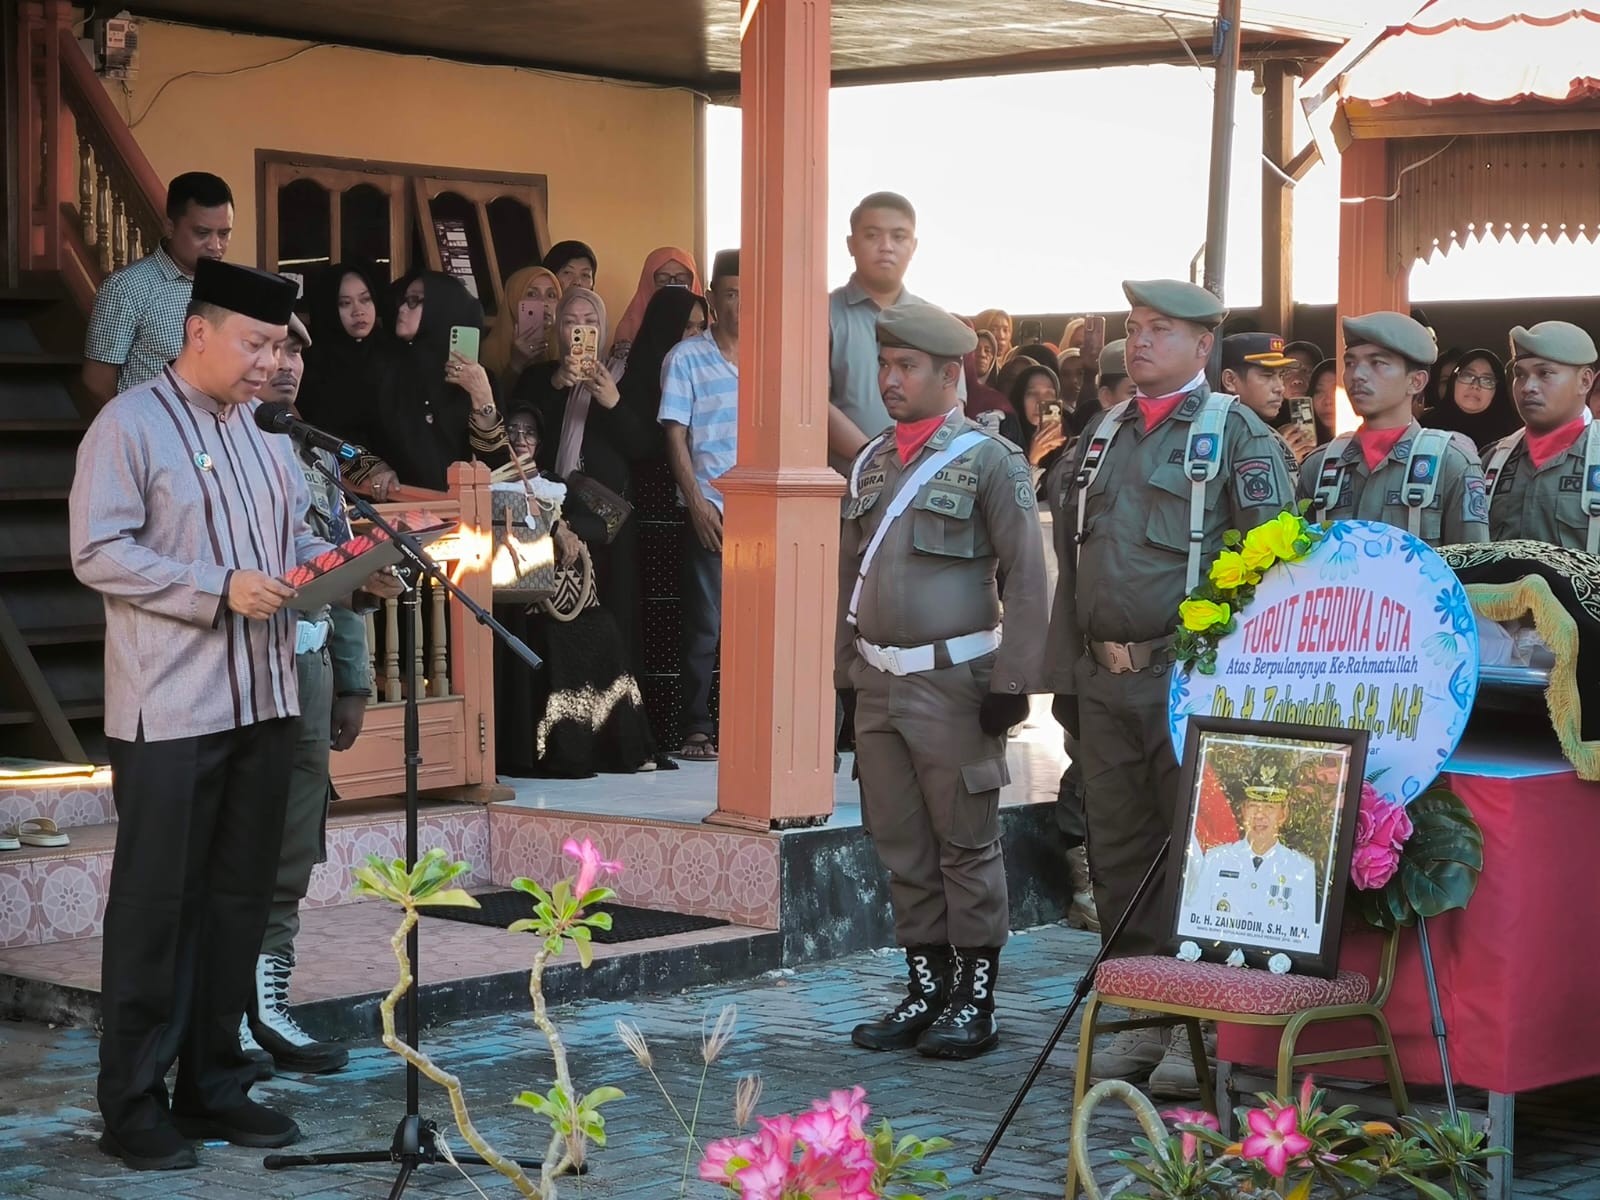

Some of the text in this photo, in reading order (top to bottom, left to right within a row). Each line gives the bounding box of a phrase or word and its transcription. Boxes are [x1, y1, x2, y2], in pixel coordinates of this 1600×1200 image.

[935, 470, 977, 486] OL PP
[1243, 586, 1412, 654] TURUT BERDUKA CITA
[1226, 654, 1418, 680] Atas Berpulangnya Ke-Rahmatullah
[1387, 682, 1423, 741] M.H
[1190, 913, 1201, 924] Dr.
[1203, 915, 1212, 926] H.
[1215, 916, 1264, 933] ZAINUDDIN,
[1267, 923, 1287, 937] S.H.,
